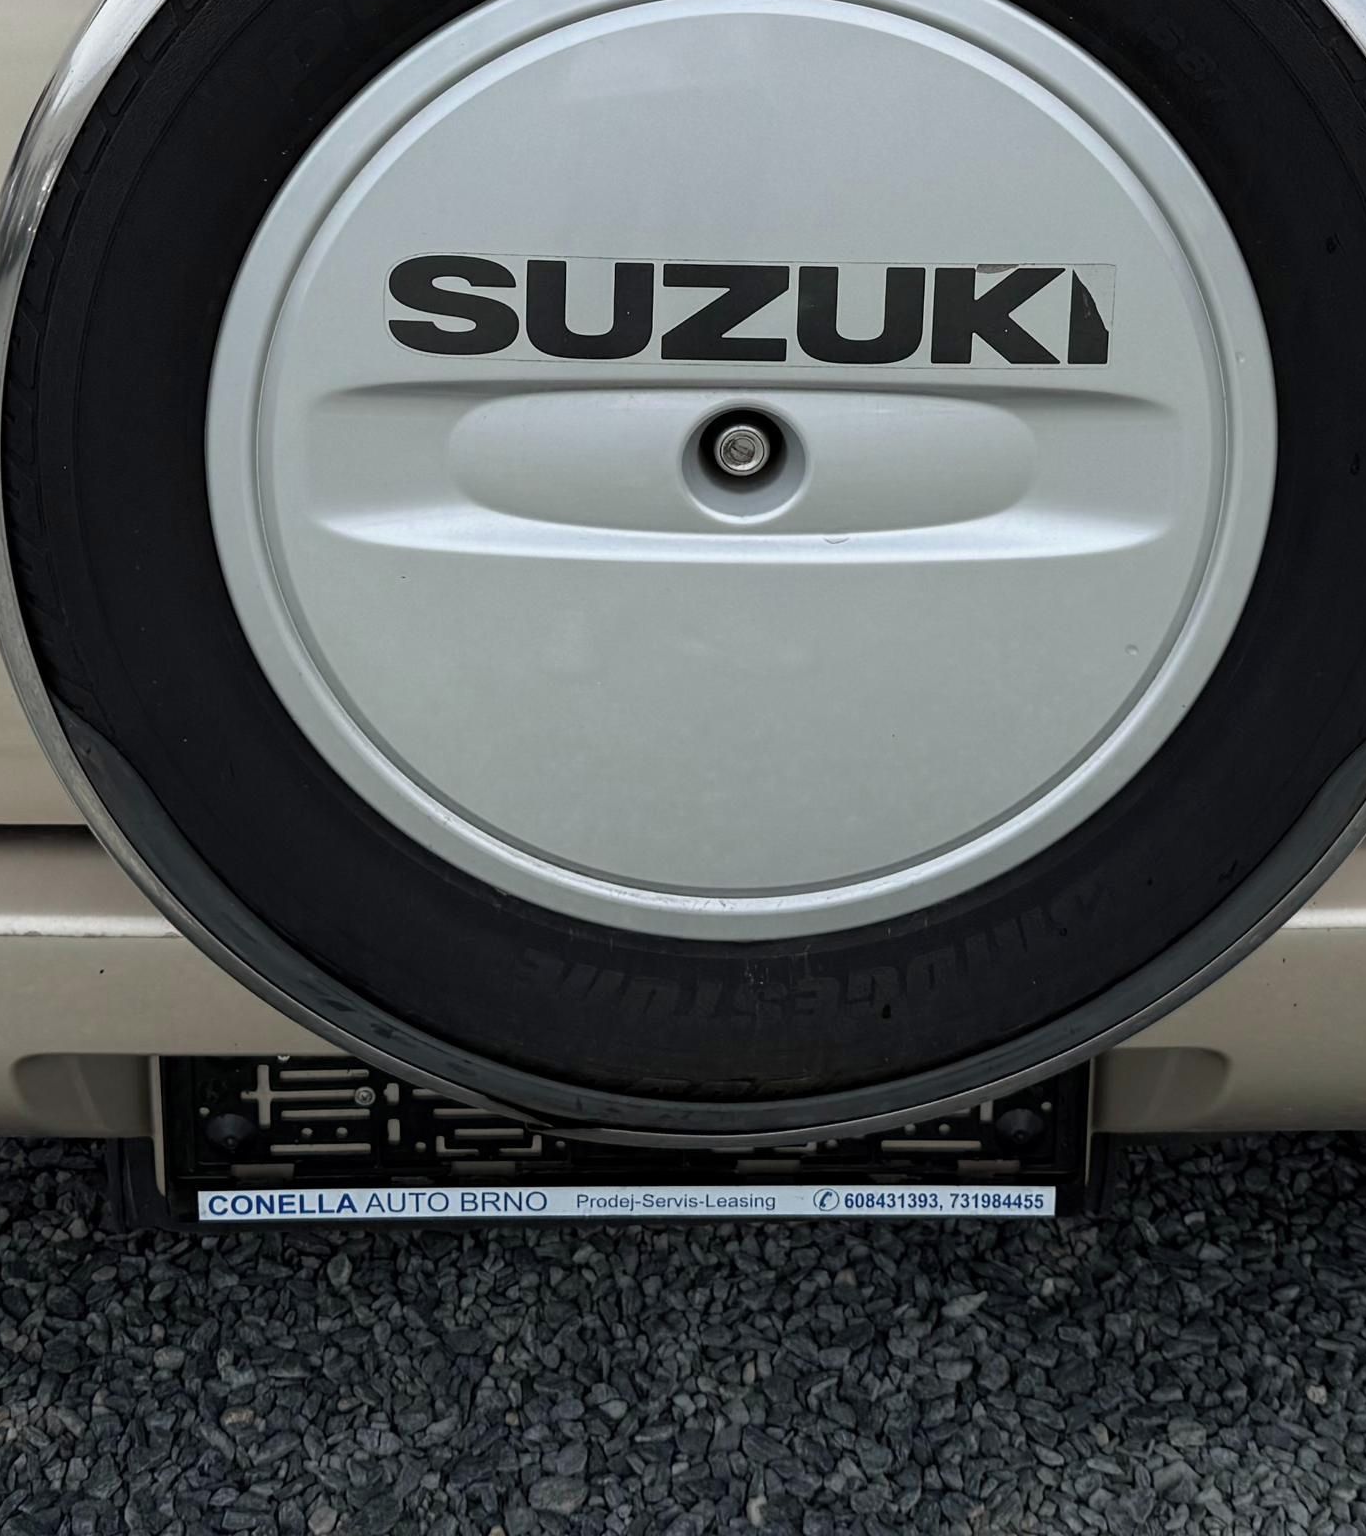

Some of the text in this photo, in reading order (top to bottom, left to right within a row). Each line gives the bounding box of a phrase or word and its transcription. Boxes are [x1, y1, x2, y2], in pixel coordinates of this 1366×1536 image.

[387, 254, 1110, 366] SUZUKI
[207, 1191, 1044, 1215] CONELLA AUTO BRNO Prodej-Servis-Leasing 608431393, 731984455
